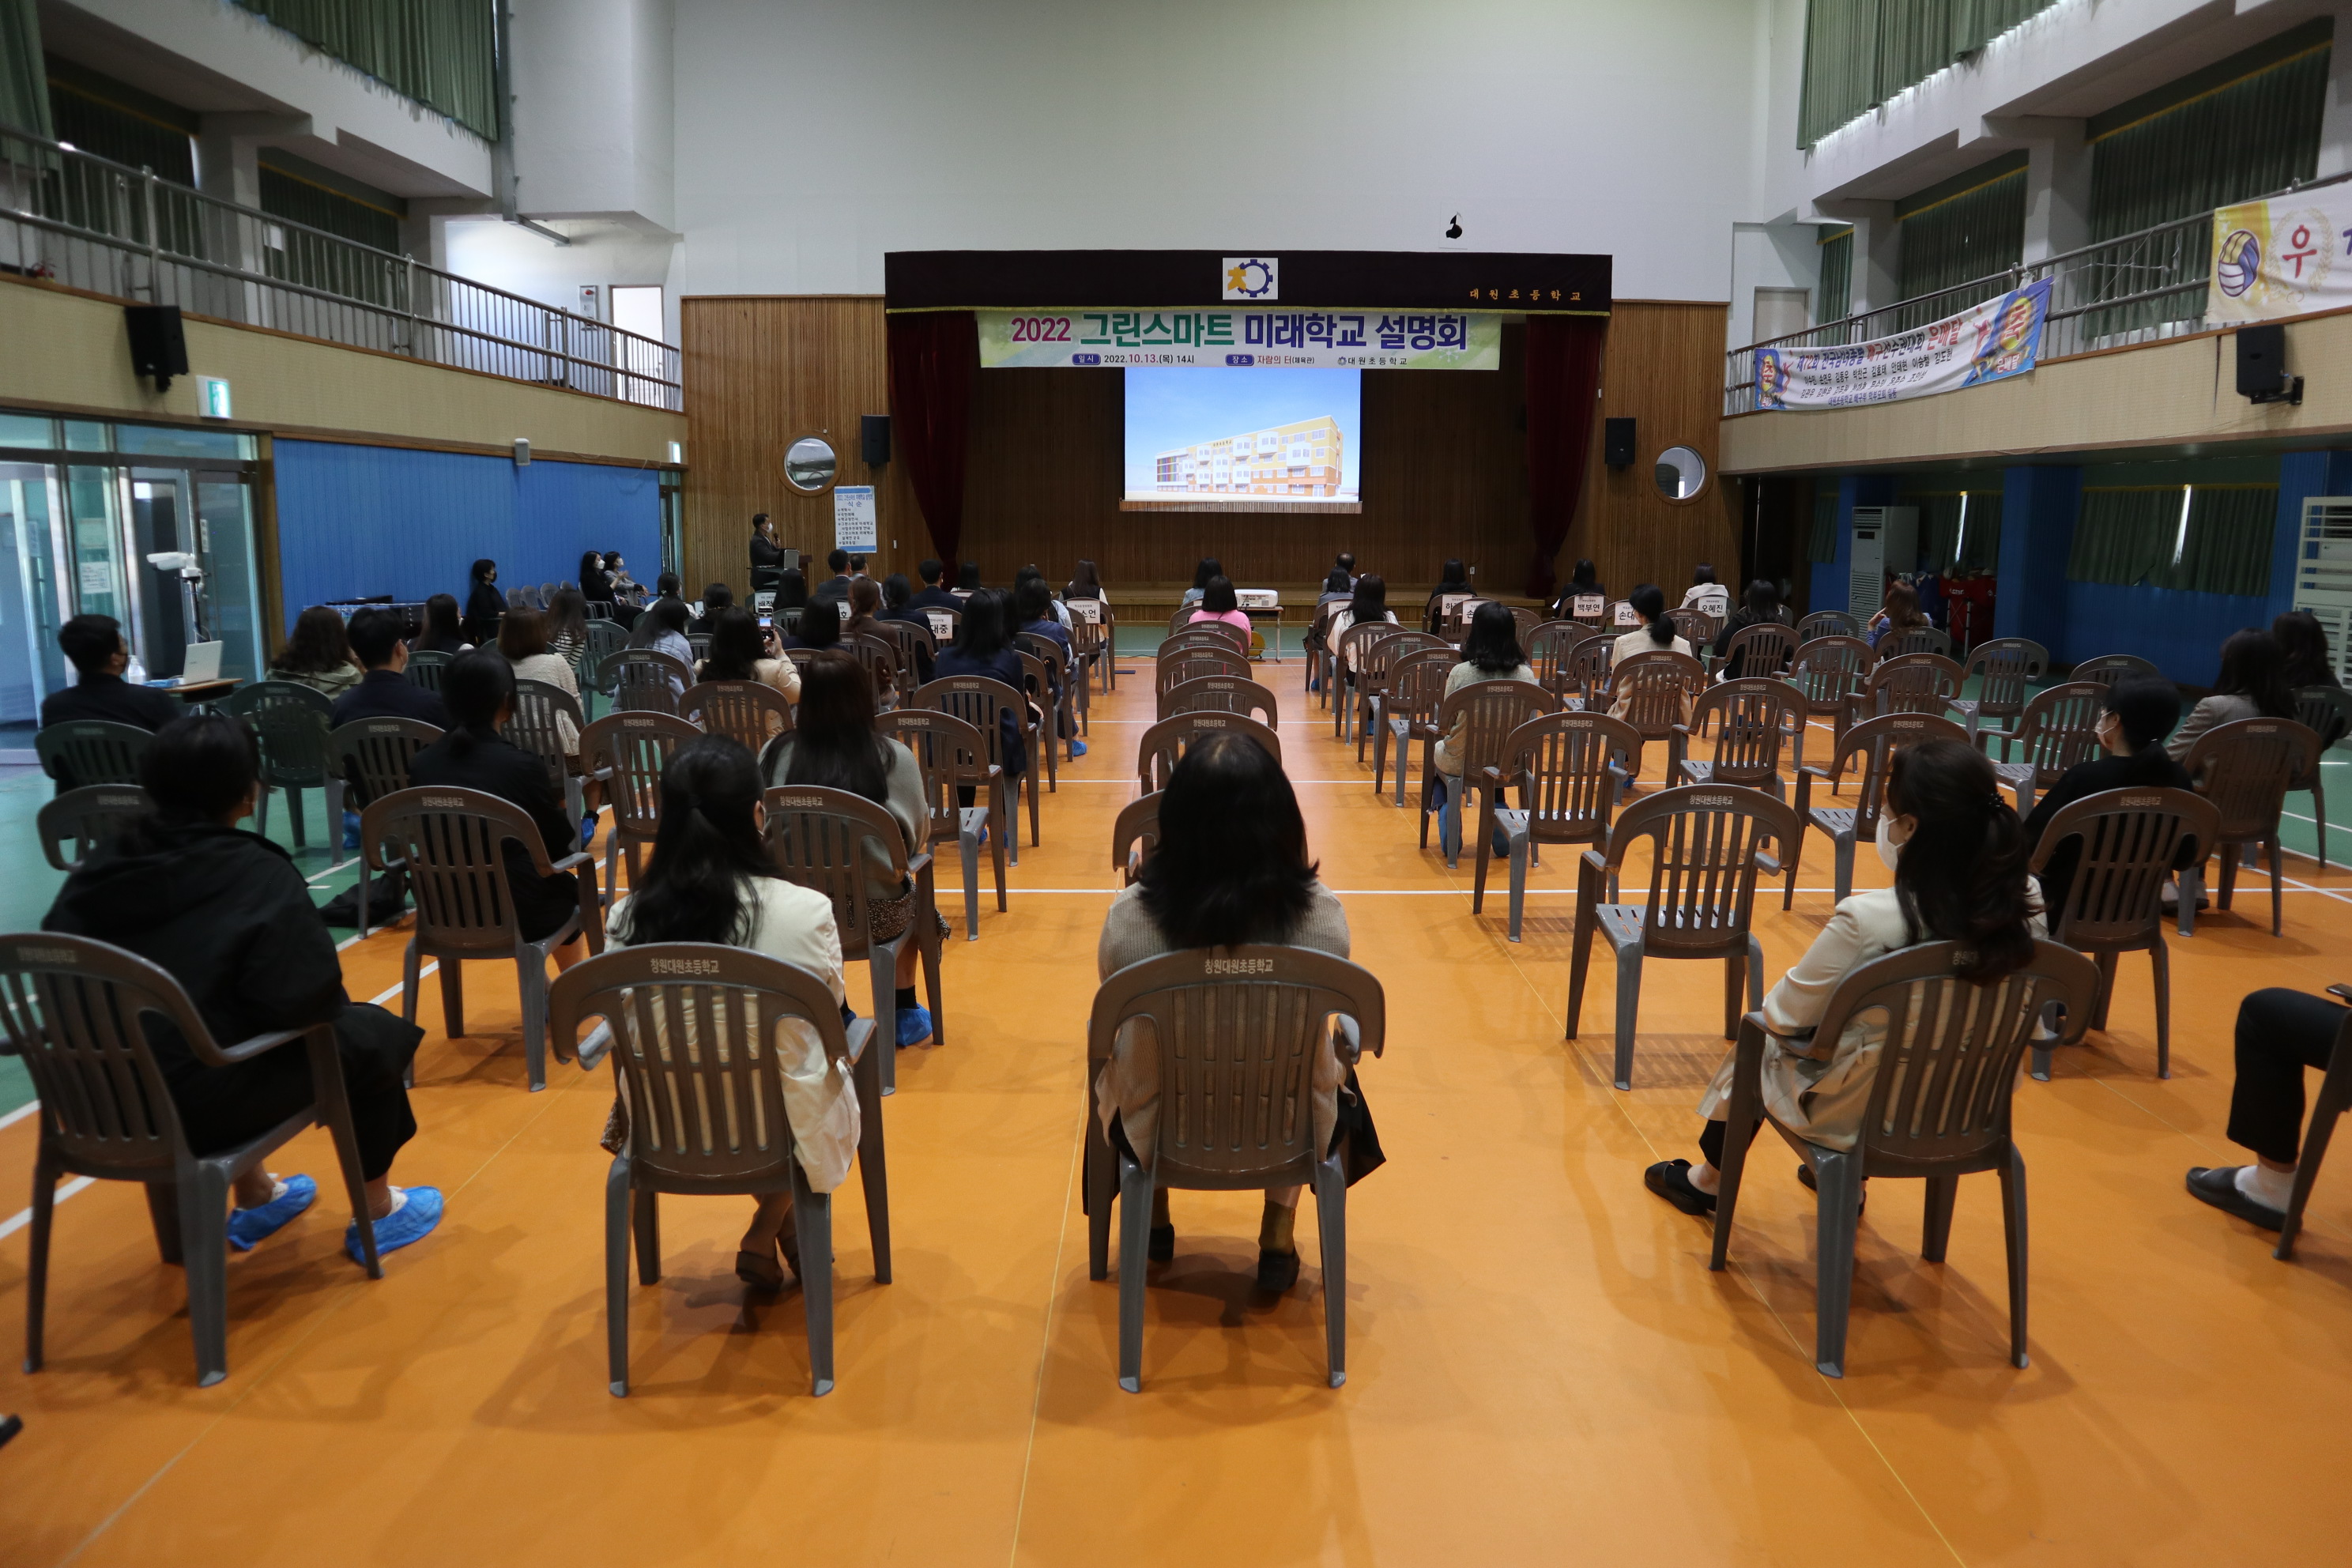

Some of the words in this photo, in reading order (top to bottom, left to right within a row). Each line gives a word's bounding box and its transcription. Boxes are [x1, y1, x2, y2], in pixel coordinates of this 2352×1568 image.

[2282, 224, 2318, 278] 우
[1469, 288, 1581, 301] 대원초등학교
[1011, 317, 1072, 341] 2022
[1080, 313, 1234, 347] 그린스마트
[1245, 313, 1366, 349] 미래학교
[1375, 315, 1467, 350] 설명회
[1927, 318, 1963, 351] 은메달
[1104, 353, 1173, 364] 2022.10.13.(목)
[1176, 355, 1194, 364] 14시
[1257, 355, 1281, 364] 자람의
[1348, 356, 1408, 365] 대원초등학교
[1997, 352, 2021, 375] 은메달
[1577, 604, 1600, 612] 백부연
[1701, 605, 1723, 613] 오혜진
[650, 958, 720, 974] 창원대원초등학교
[1204, 958, 1274, 974] 창원대원초등학교
